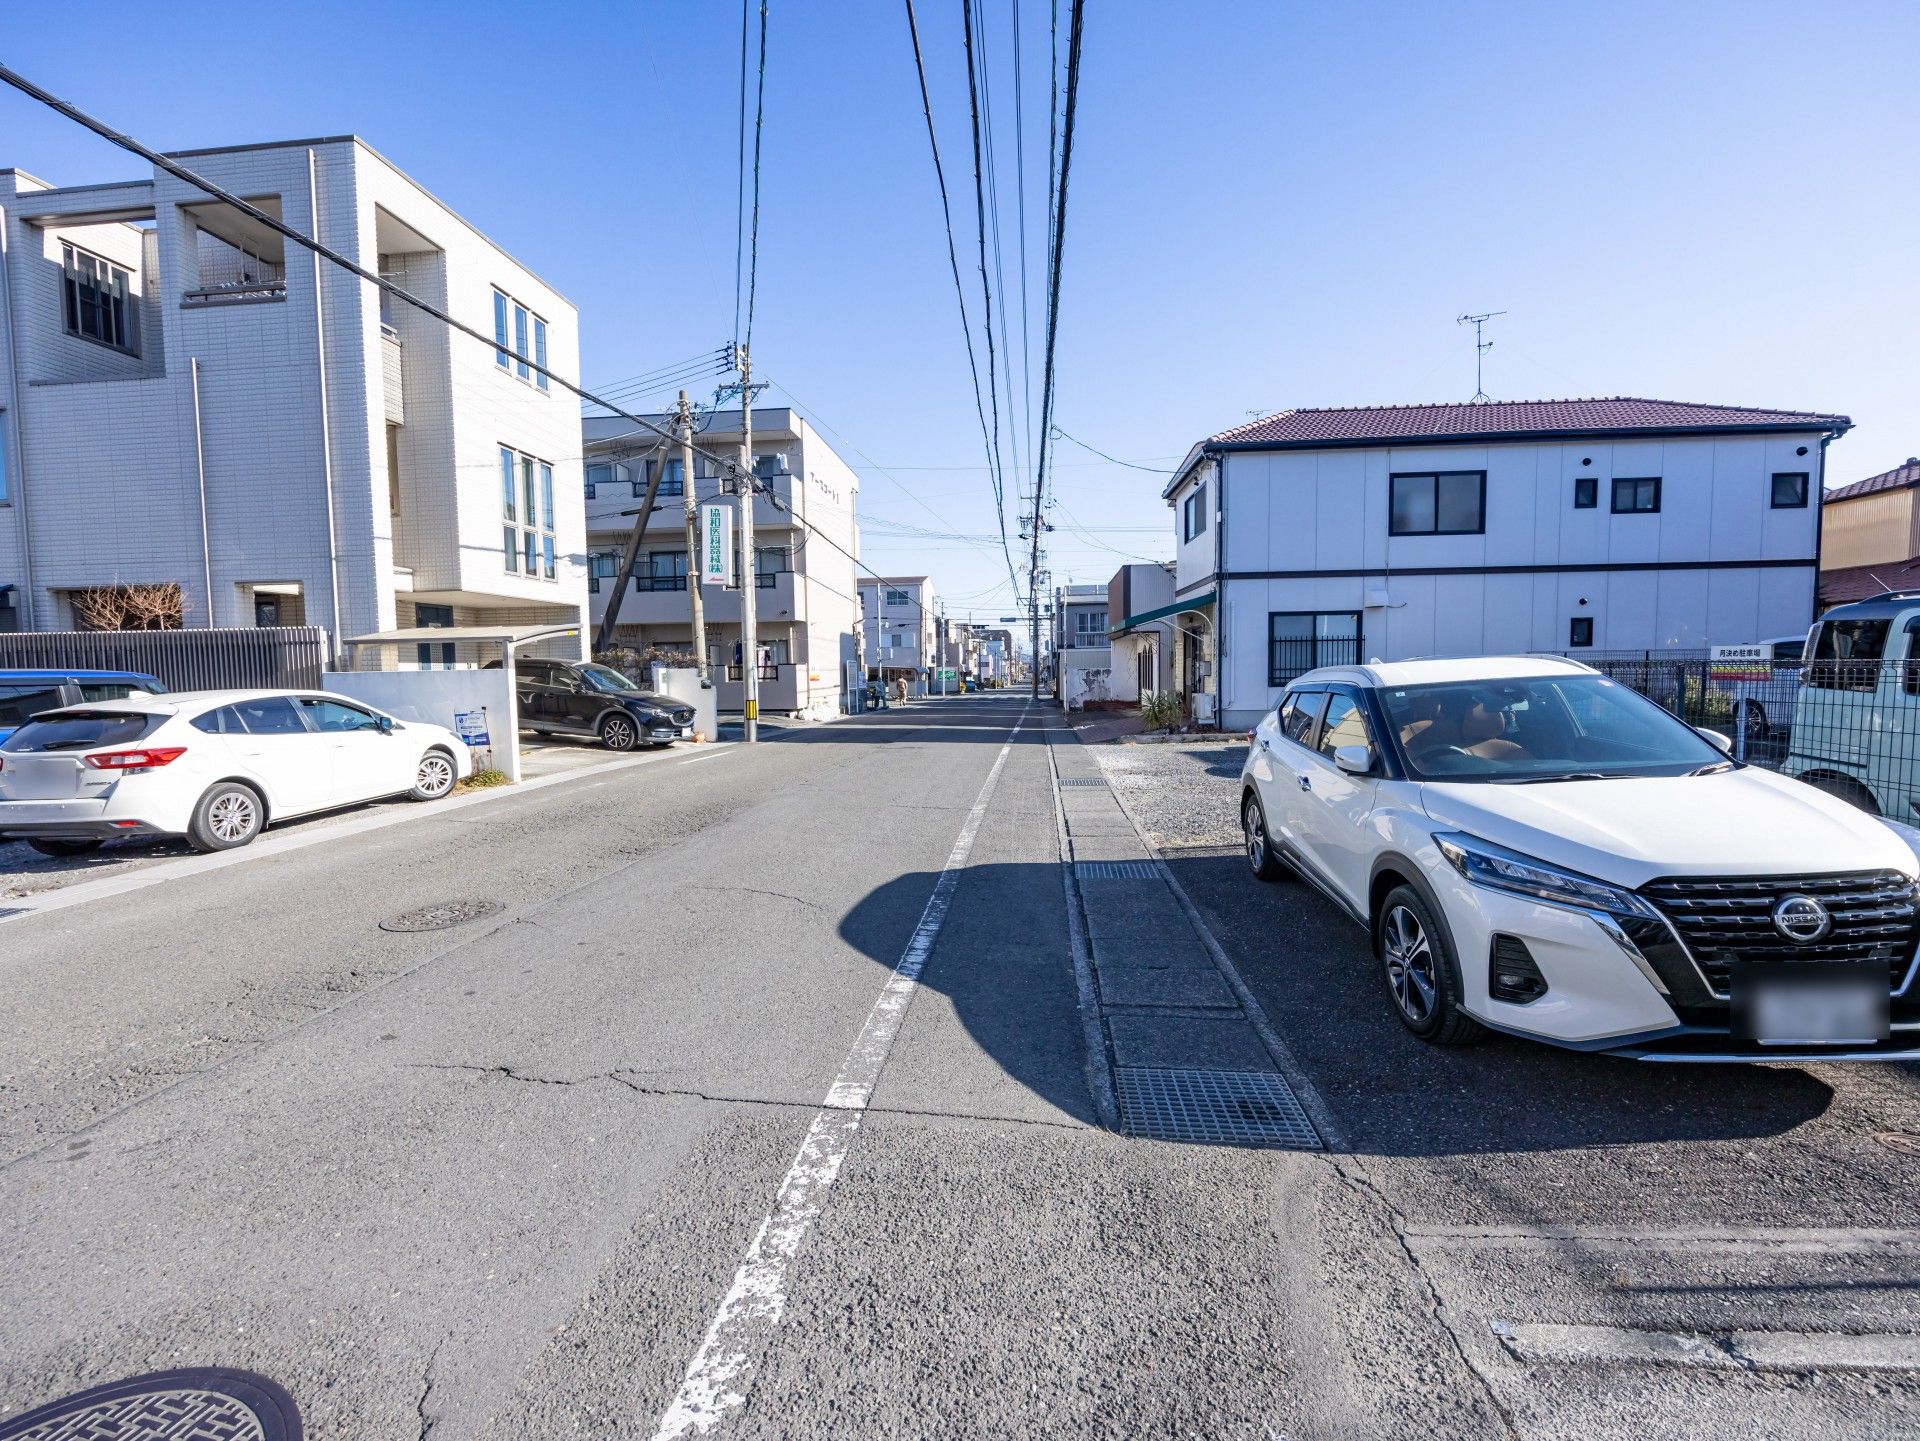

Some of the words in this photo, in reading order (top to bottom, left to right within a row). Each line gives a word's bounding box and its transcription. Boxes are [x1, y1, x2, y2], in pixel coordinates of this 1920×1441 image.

[1720, 649, 1761, 657] 月決め駐車場
[1781, 915, 1824, 923] NISSAN
